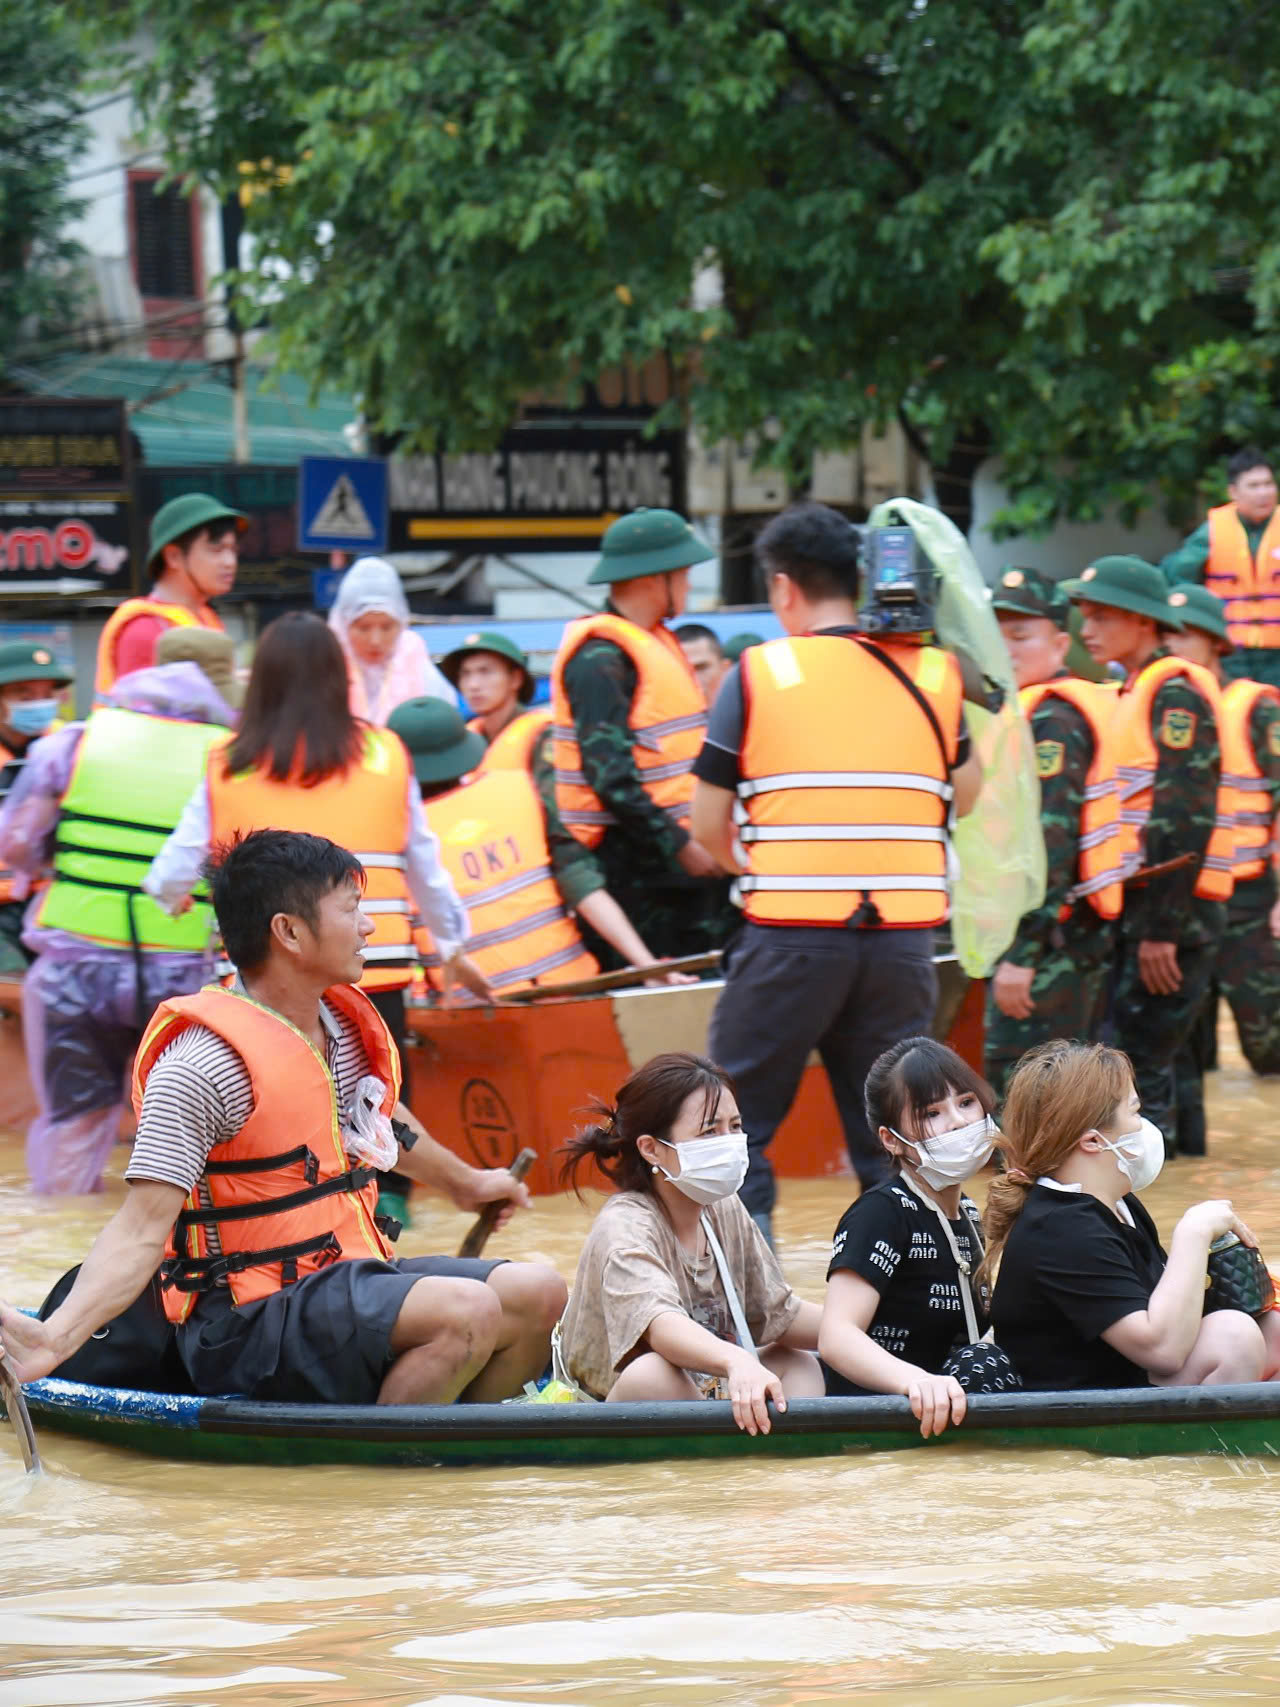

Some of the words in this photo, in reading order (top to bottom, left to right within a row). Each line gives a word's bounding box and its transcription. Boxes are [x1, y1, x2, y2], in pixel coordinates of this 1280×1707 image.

[874, 1240, 901, 1266] min
[908, 1247, 937, 1259] min
[869, 1252, 894, 1277] min
[930, 1283, 959, 1297] min
[929, 1297, 961, 1311] min
